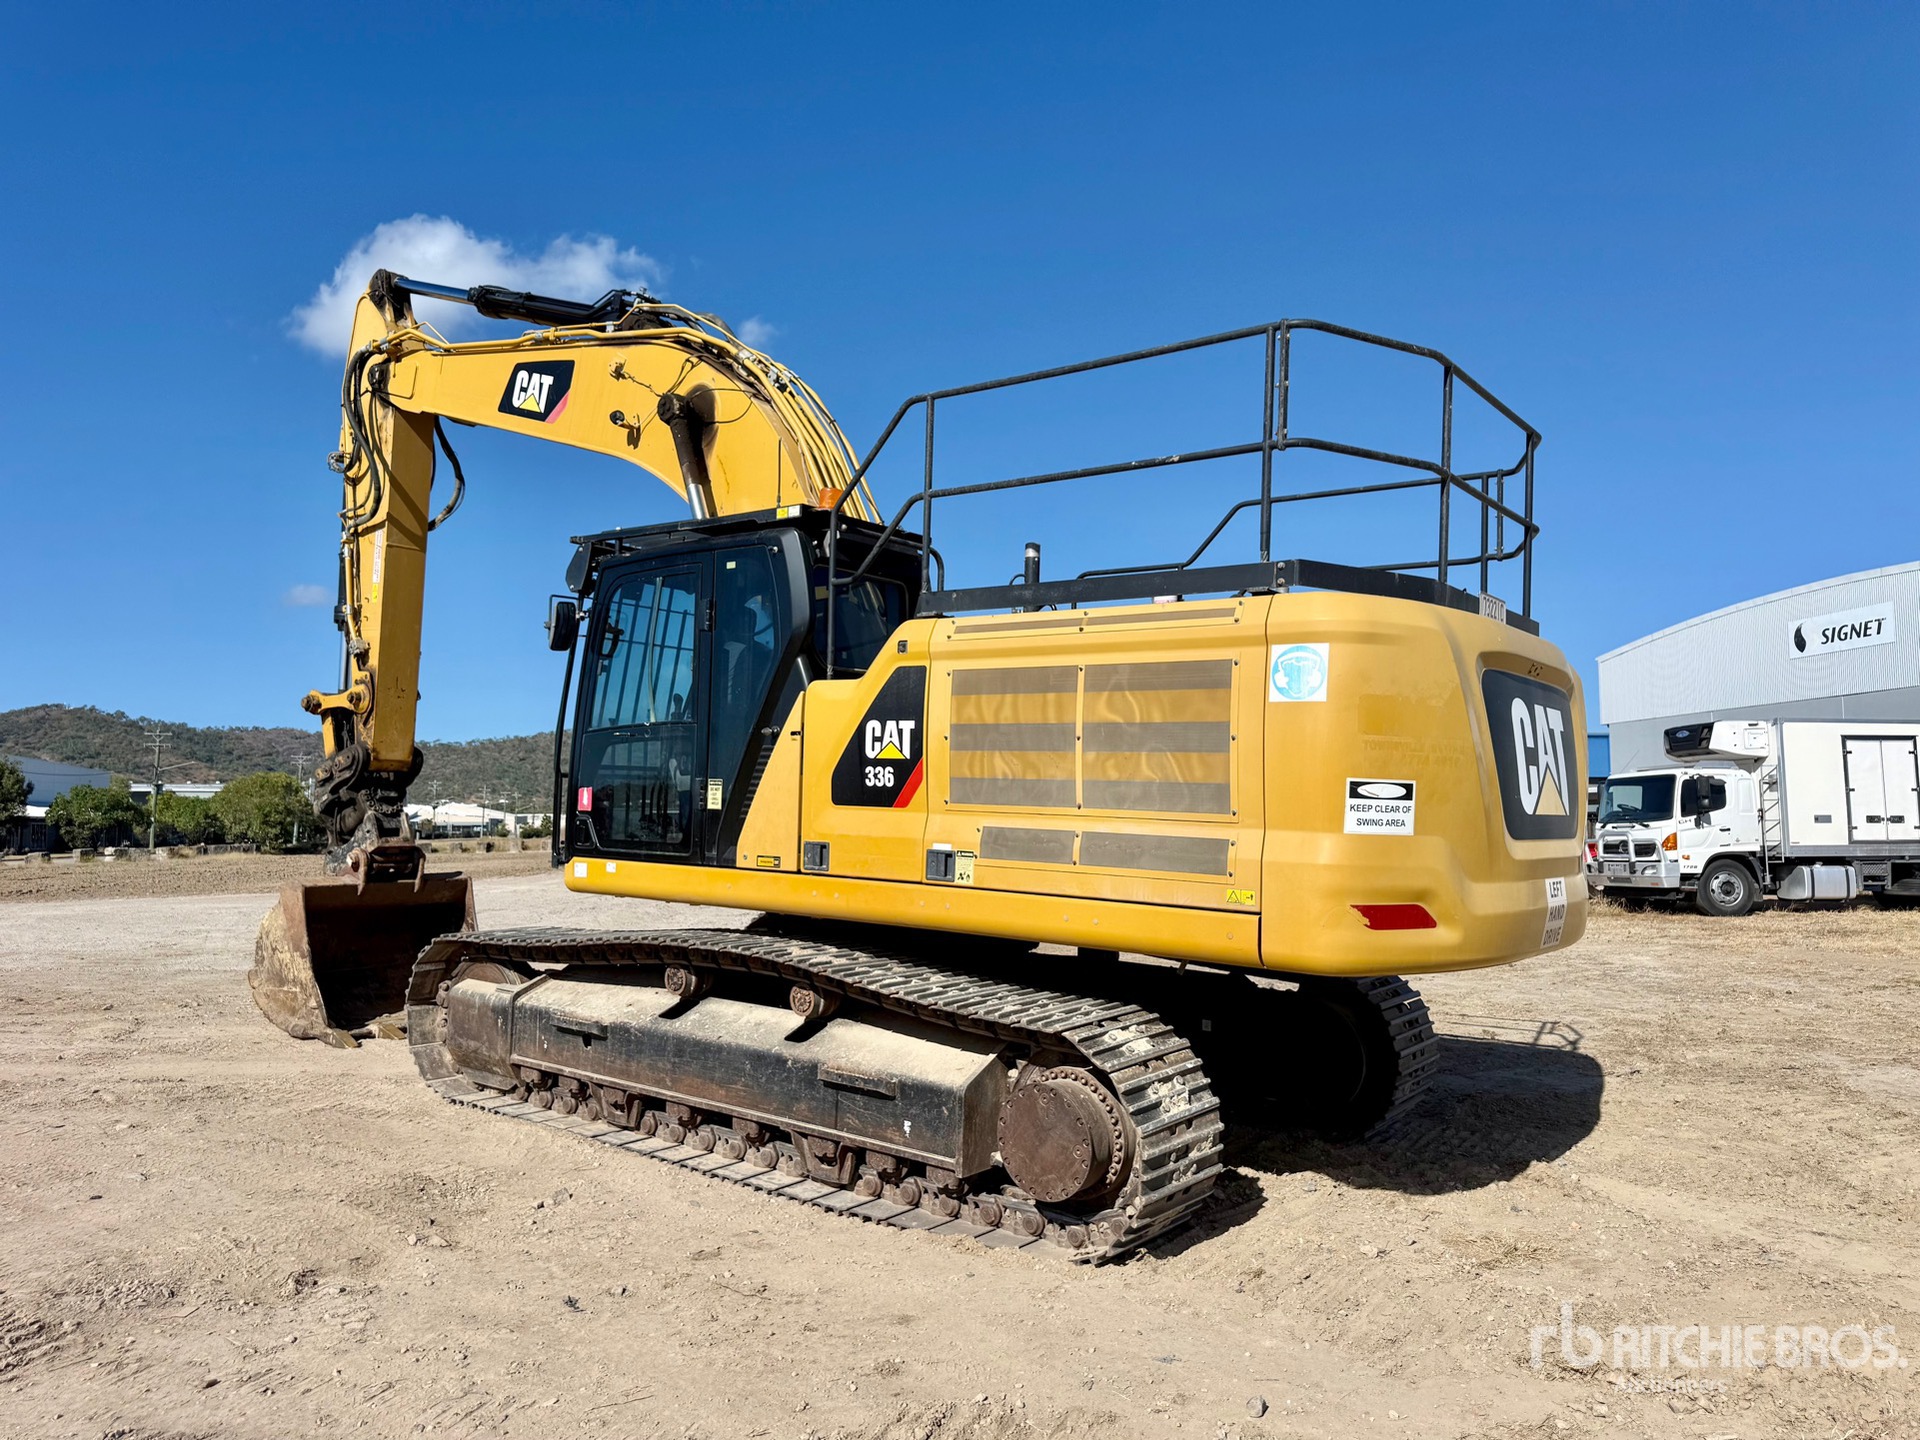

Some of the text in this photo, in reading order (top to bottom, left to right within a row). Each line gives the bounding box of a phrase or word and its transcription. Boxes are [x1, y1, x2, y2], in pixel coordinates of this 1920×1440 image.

[512, 369, 555, 414] CAT
[1821, 618, 1884, 645] SIGNET
[864, 719, 916, 760] CAT
[1511, 697, 1570, 816] CAT
[864, 765, 895, 788] 336
[1349, 803, 1412, 814] KEEP CLEAR OF
[1356, 817, 1406, 828] SWING AREA
[1549, 880, 1563, 898] LEFT
[1548, 904, 1565, 922] HAND
